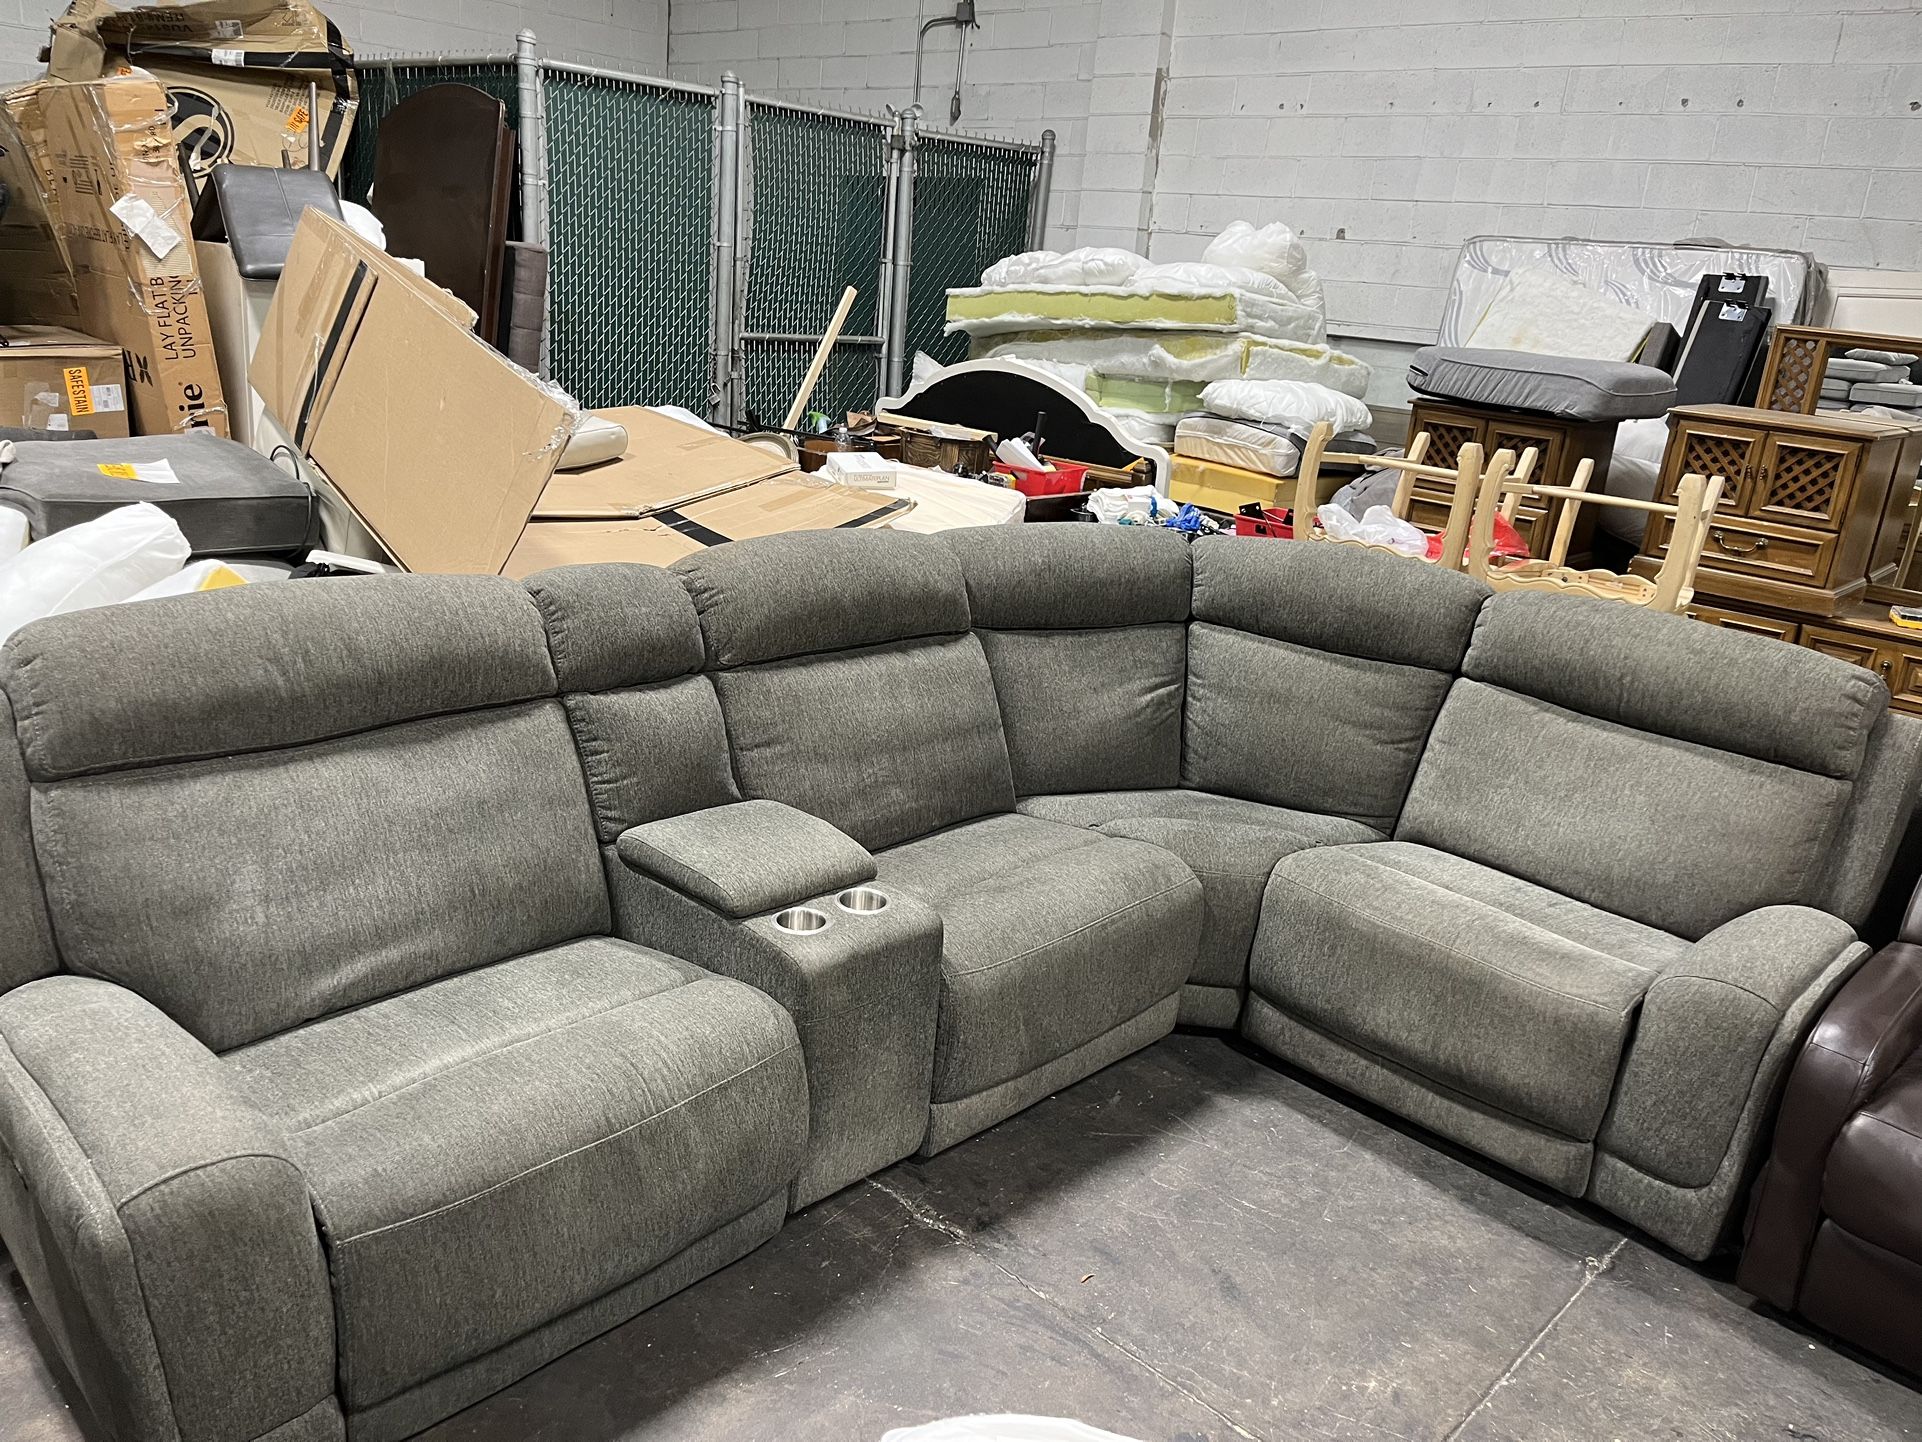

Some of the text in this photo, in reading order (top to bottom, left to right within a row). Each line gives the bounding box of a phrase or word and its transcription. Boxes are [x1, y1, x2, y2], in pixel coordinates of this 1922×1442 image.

[152, 290, 172, 328] FLAT
[168, 275, 197, 359] UNPACKIN
[160, 332, 179, 360] LAY
[68, 369, 90, 414] SAFESTAIN
